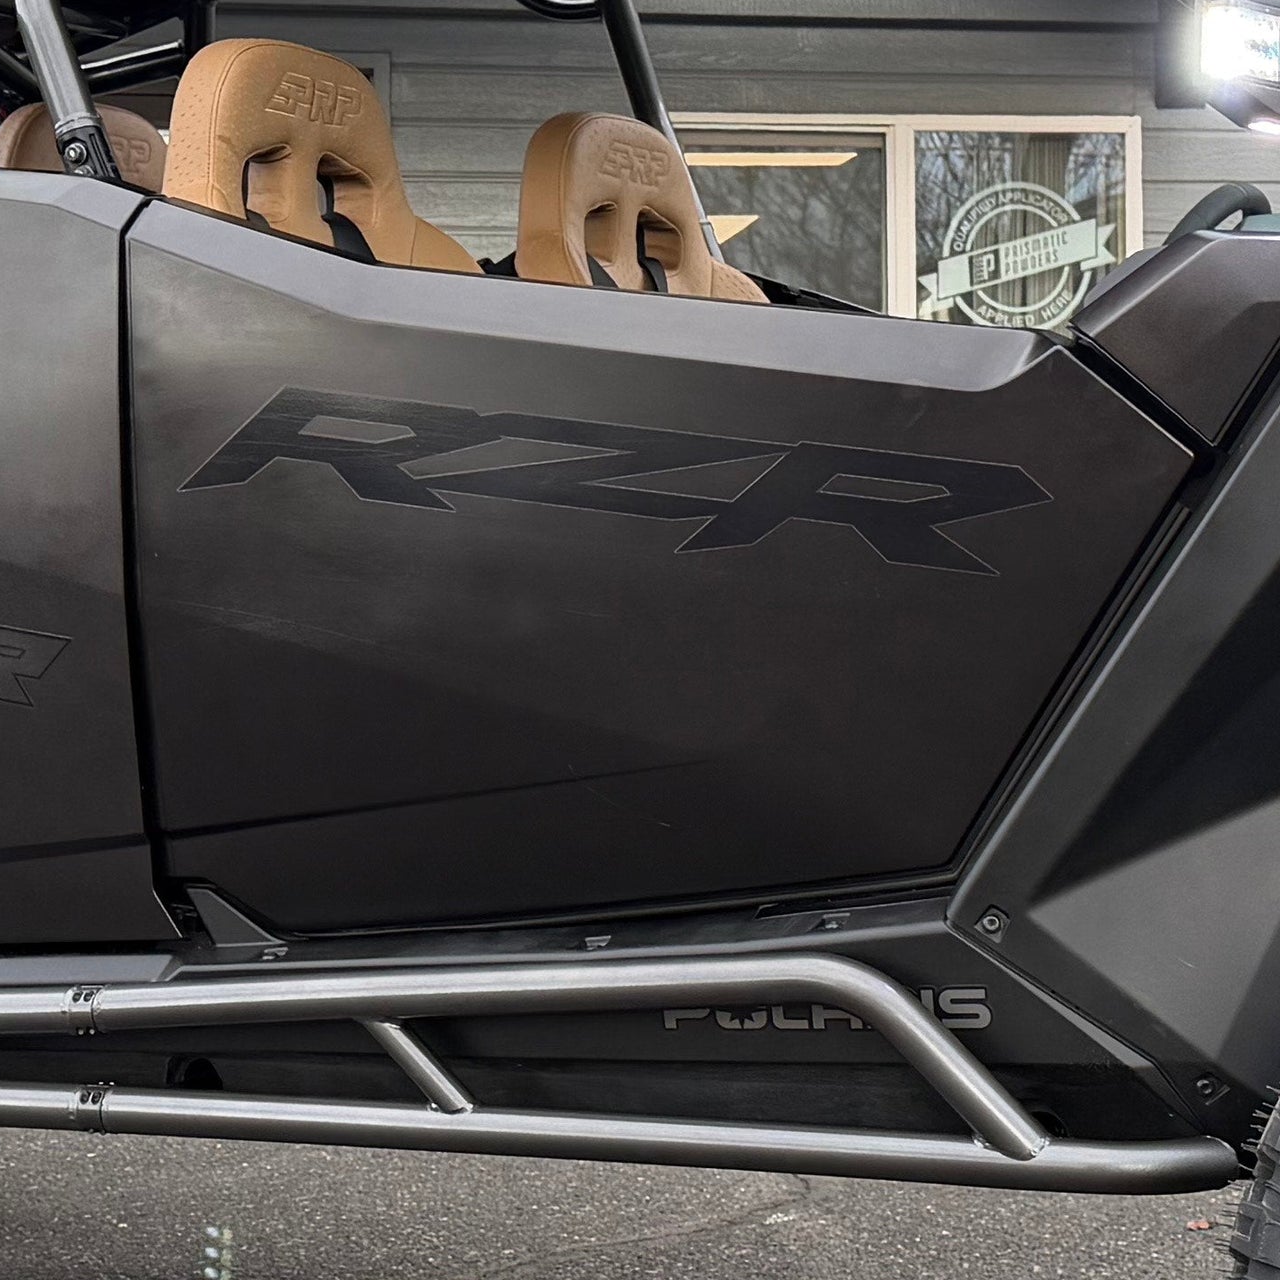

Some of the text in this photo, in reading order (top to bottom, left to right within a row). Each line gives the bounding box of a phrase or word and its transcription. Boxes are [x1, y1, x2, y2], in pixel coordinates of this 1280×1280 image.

[1004, 230, 1068, 260] PRISMATIC
[1005, 248, 1059, 276] POWDERS
[178, 385, 1054, 576] RZR
